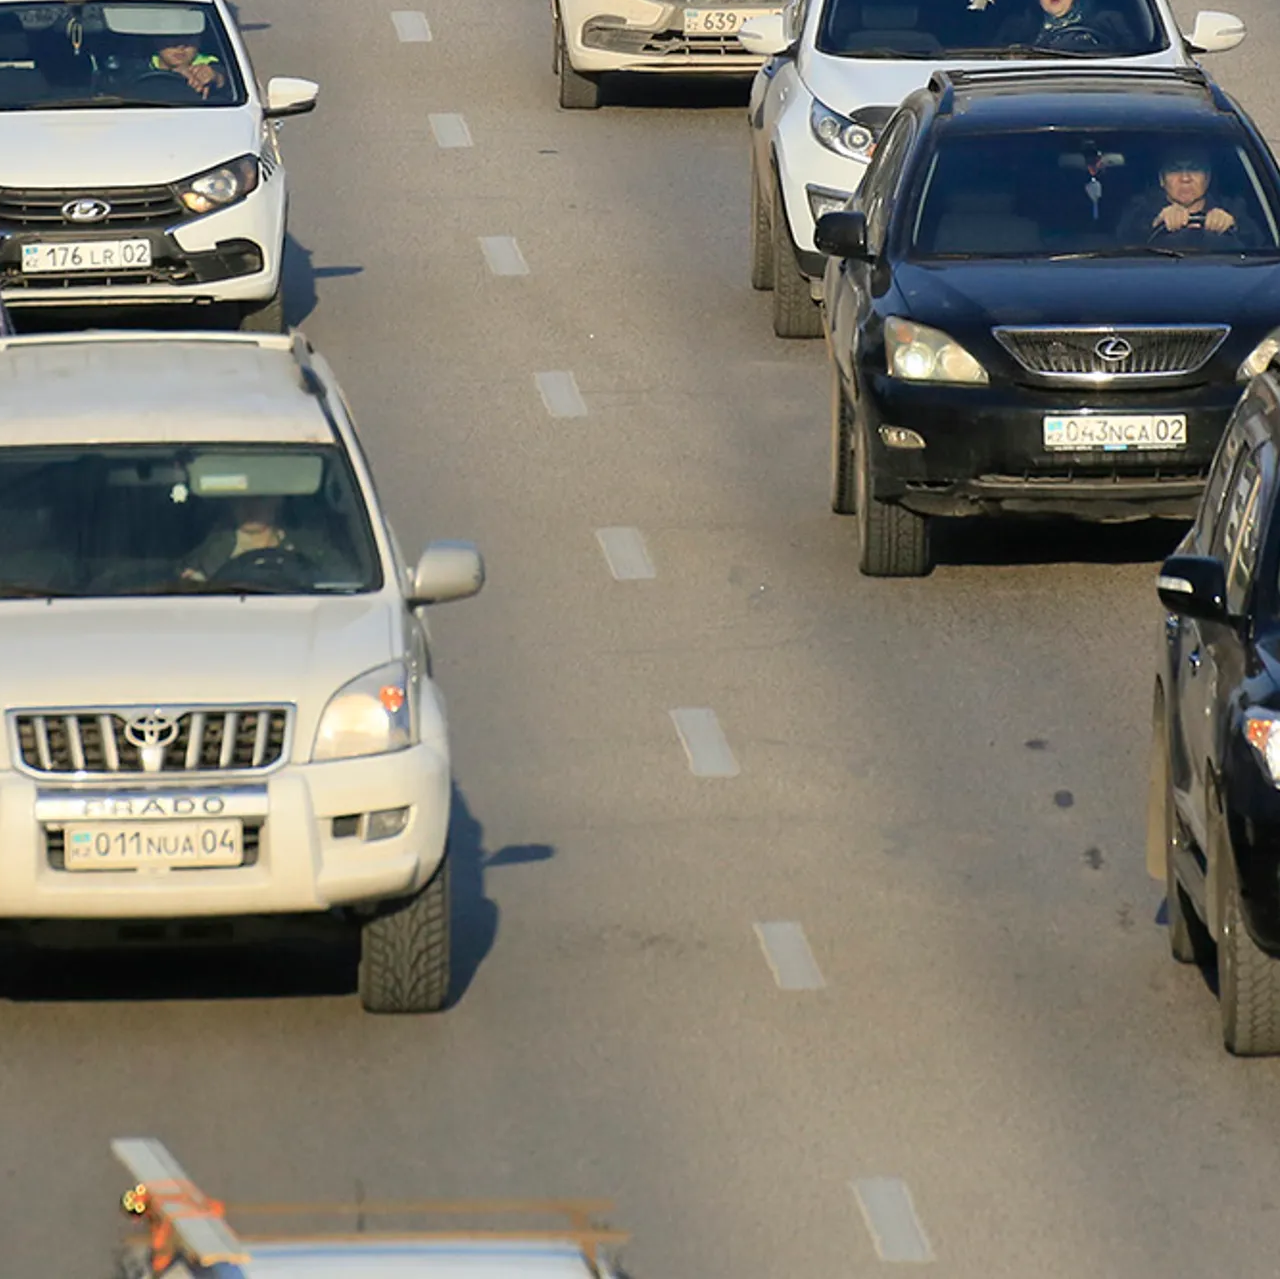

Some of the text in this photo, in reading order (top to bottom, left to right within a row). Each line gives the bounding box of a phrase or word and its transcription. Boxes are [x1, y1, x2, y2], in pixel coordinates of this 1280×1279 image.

[47, 244, 147, 267] 176 LR 02
[1155, 418, 1183, 441] 02
[200, 828, 236, 854] 04
